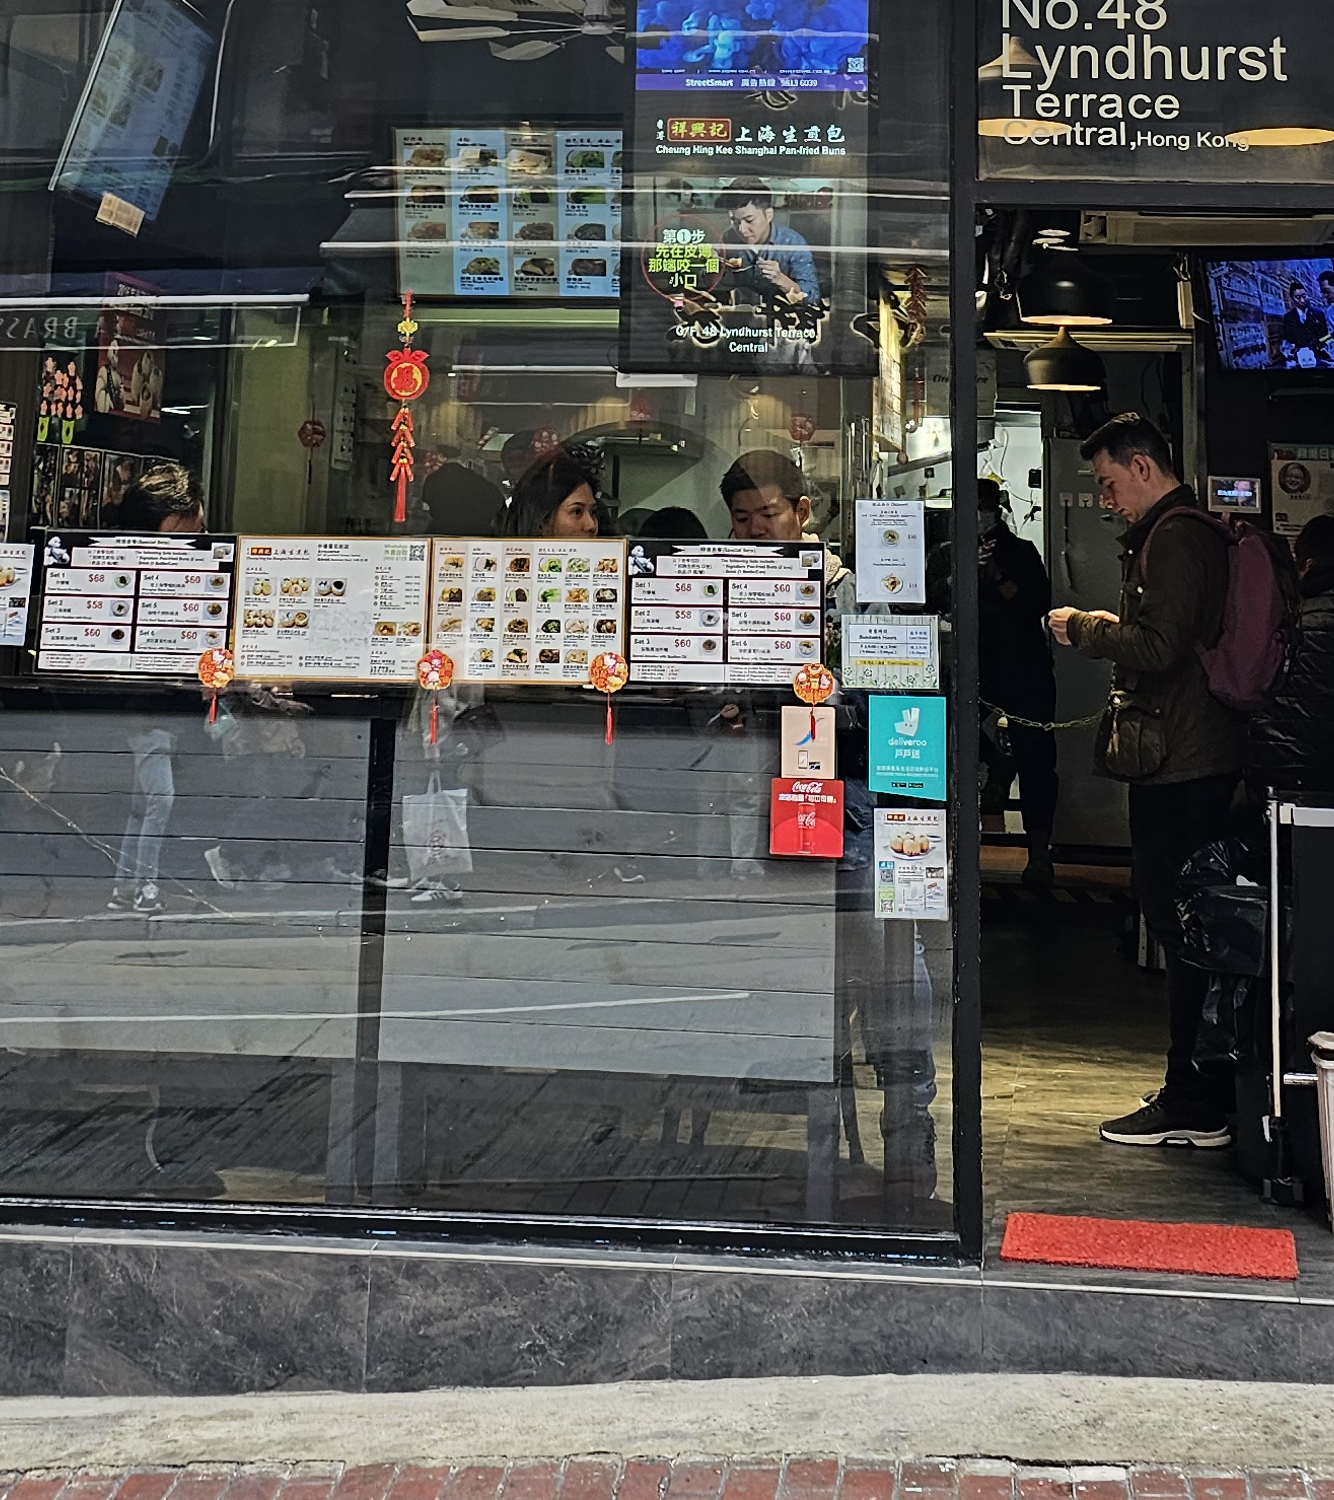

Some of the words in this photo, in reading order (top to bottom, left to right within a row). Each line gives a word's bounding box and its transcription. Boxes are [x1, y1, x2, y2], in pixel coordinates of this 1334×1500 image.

[1002, 32, 1288, 91] Lyndhurst
[1002, 86, 1181, 121] Terrace
[671, 121, 728, 139] 祥興記
[735, 124, 845, 143] 上海生煎包
[655, 145, 691, 156] Cheung
[692, 145, 714, 156] Hing
[715, 145, 733, 155] Kee
[735, 145, 777, 157] Shanghai
[779, 145, 819, 156] Pan-fried
[821, 145, 846, 156] Buns
[720, 326, 773, 338] Lyndhurst
[728, 342, 768, 353] Central
